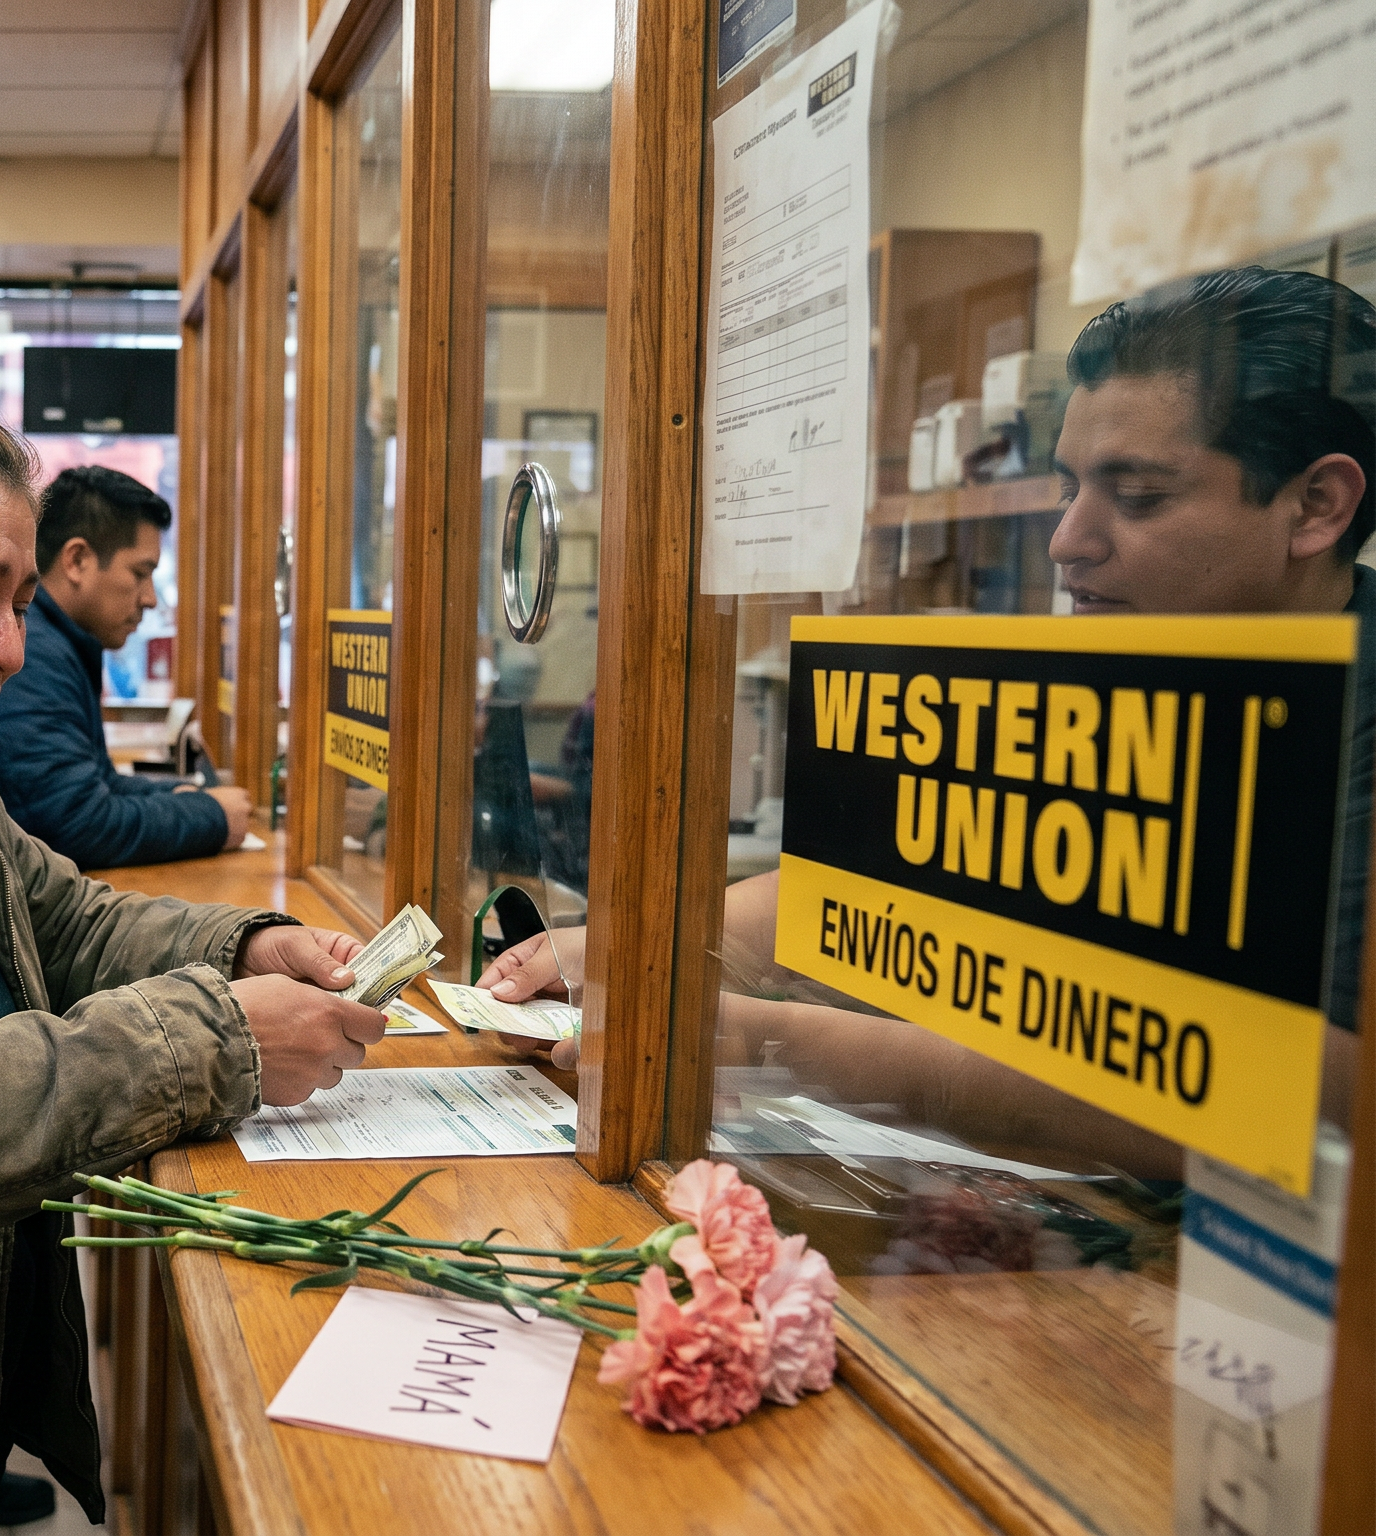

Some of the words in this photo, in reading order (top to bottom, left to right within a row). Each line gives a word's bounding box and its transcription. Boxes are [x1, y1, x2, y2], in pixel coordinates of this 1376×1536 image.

[331, 632, 388, 675] WESTERN
[346, 673, 386, 717] UNION
[812, 669, 1180, 804] WESTERN
[895, 773, 1171, 927] UNION
[820, 897, 940, 998] ENVÍOS
[952, 943, 1006, 1026] DE
[1018, 966, 1214, 1108] DINERO
[389, 1318, 499, 1431] MAMÁ
